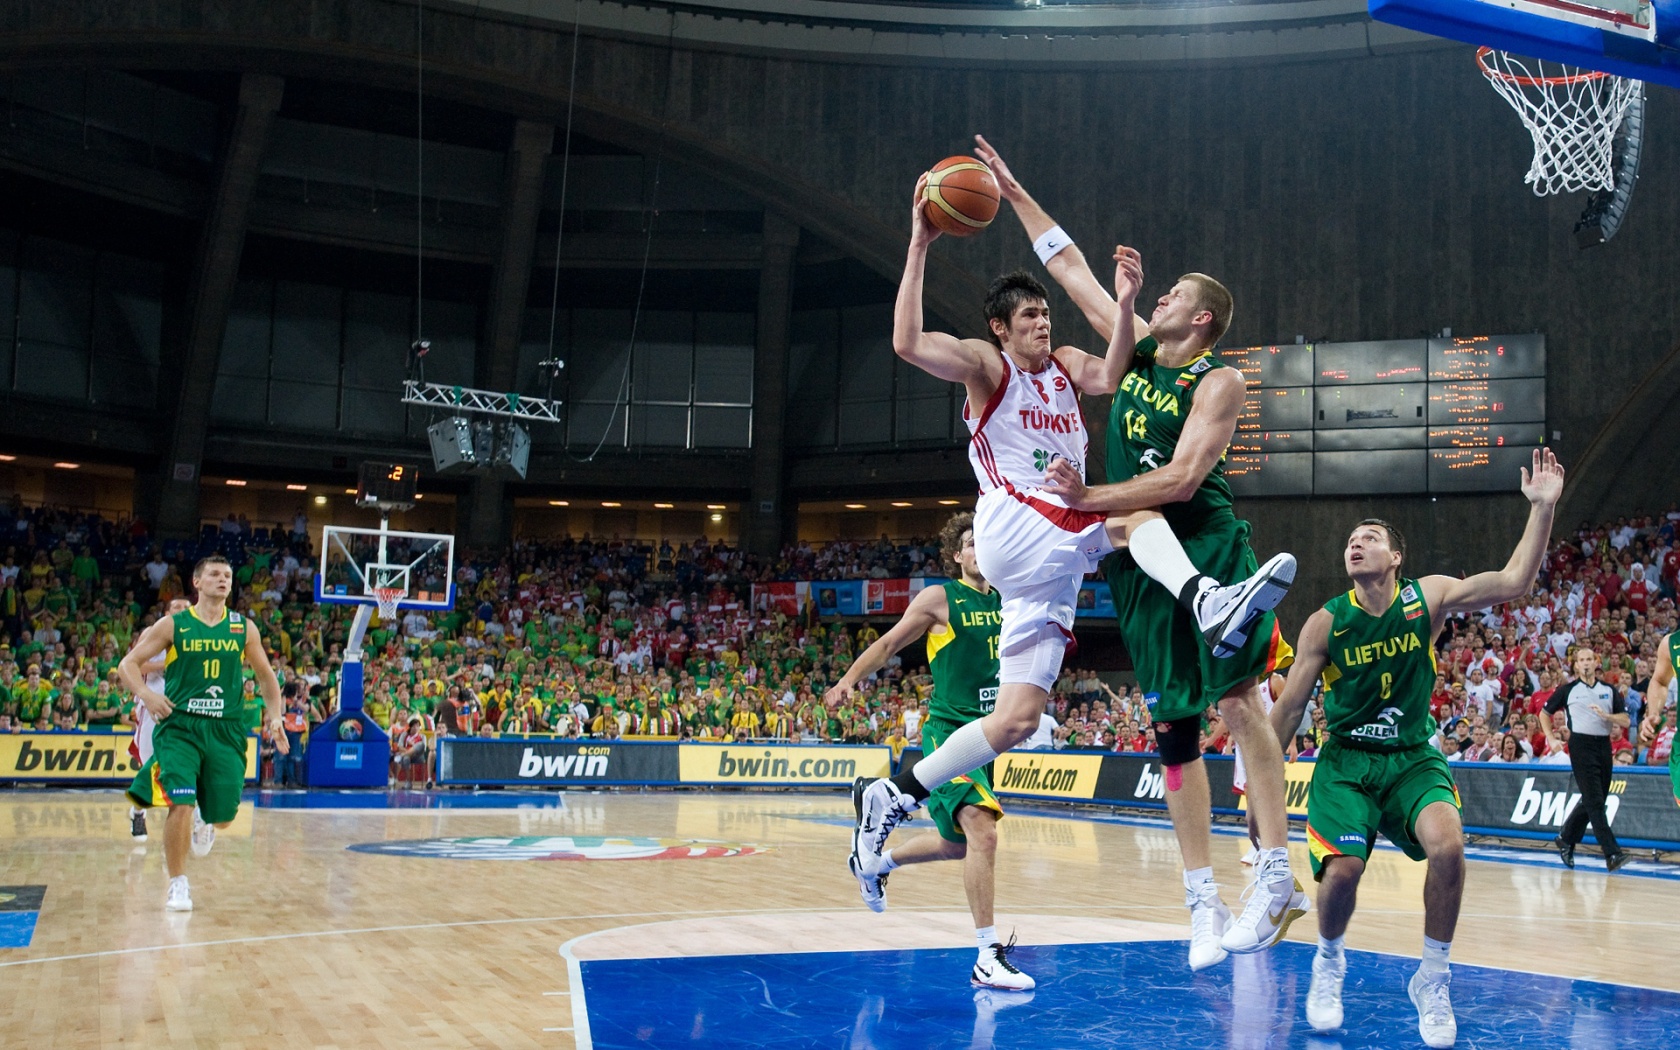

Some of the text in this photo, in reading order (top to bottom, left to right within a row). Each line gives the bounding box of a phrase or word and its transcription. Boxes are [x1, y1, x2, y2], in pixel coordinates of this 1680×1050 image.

[1121, 372, 1179, 417] ETUVA
[1125, 409, 1147, 440] 14
[182, 639, 239, 651] LIETUVA
[1344, 632, 1422, 667] LIETUVA
[203, 658, 220, 679] 10
[191, 700, 222, 708] ORLEN
[1355, 725, 1396, 738] ORLEN
[718, 750, 856, 778] bwin.com
[1001, 759, 1078, 792] bwin.com
